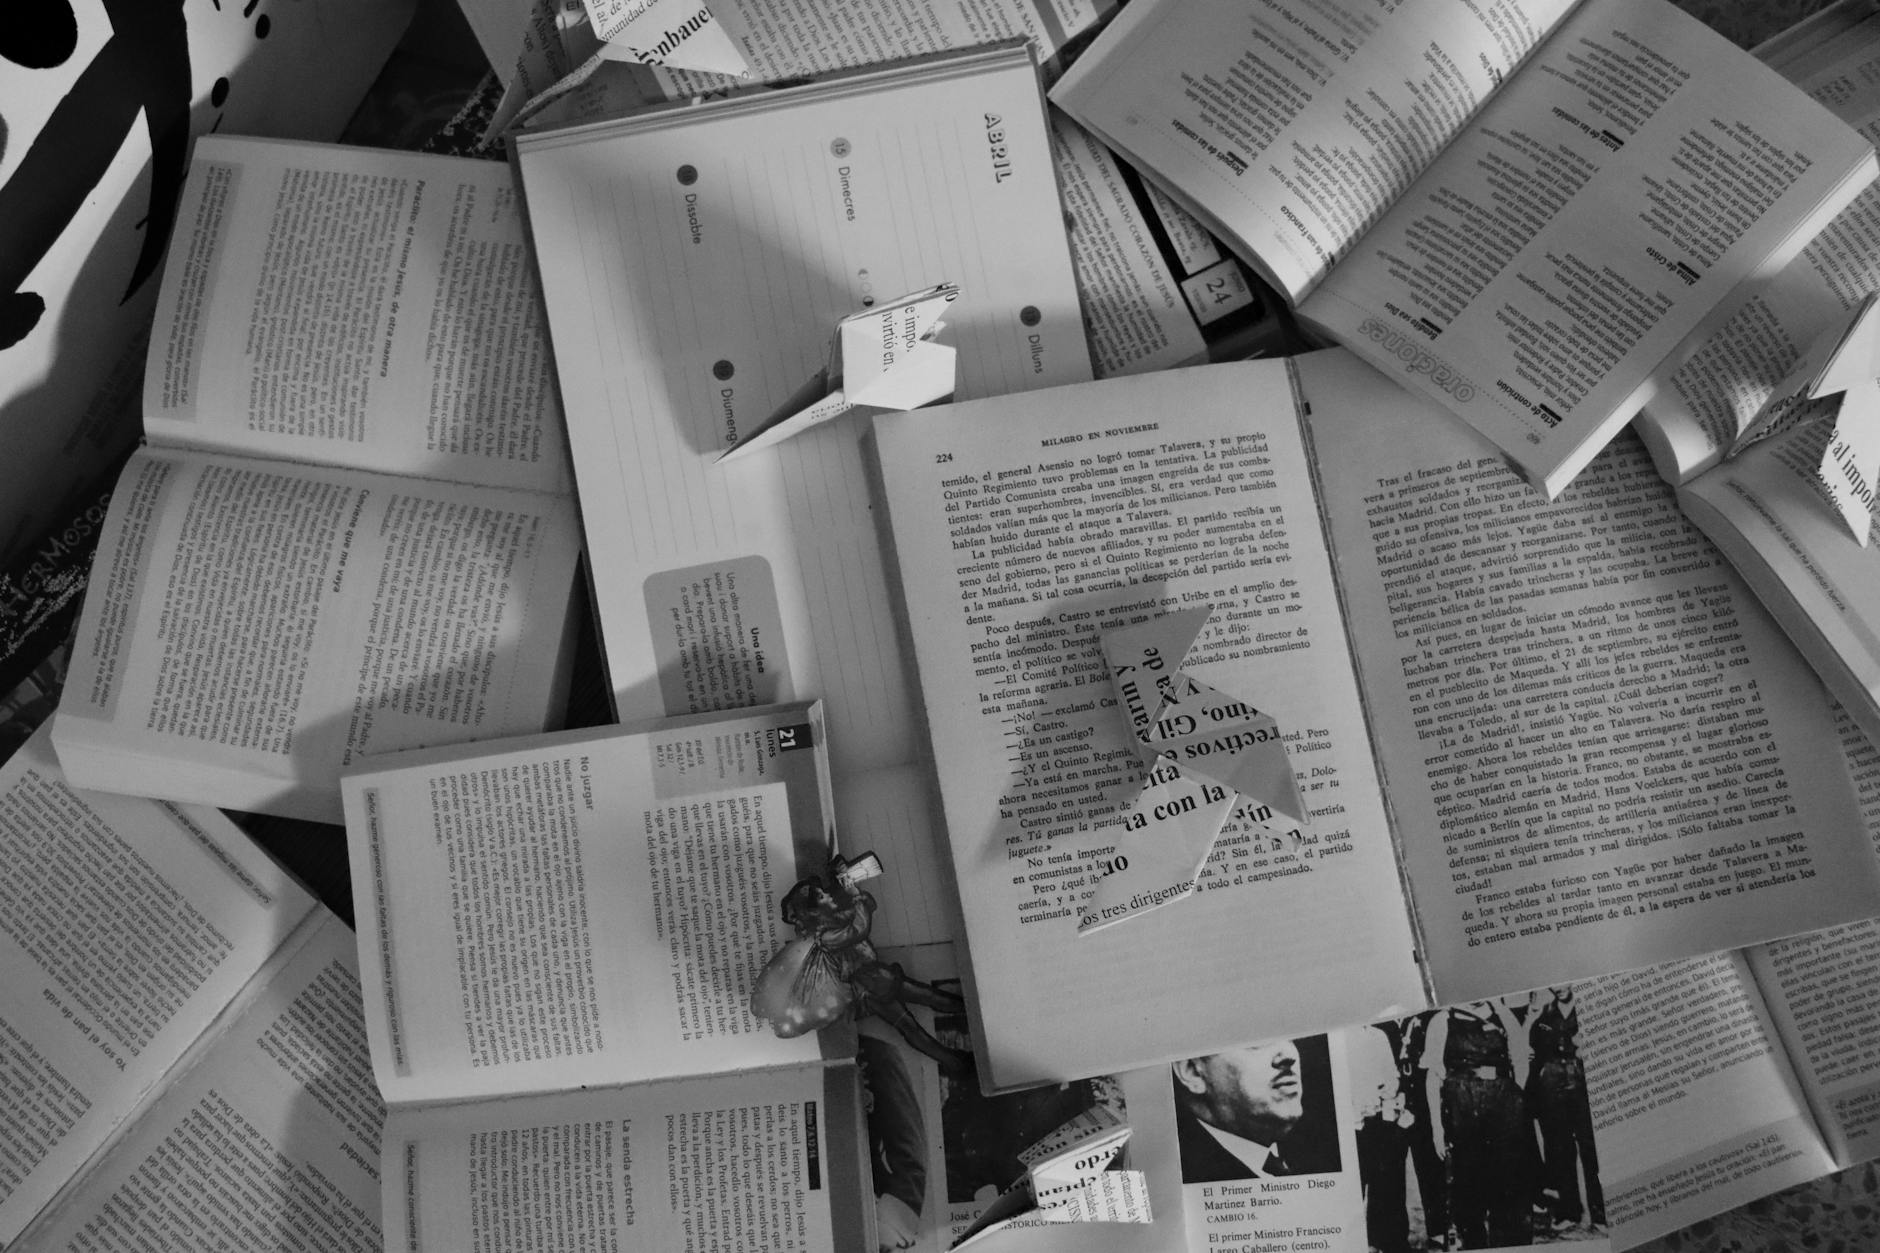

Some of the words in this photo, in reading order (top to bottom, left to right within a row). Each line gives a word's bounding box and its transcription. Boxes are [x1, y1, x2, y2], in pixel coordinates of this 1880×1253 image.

[983, 112, 1012, 184] ABRIL
[837, 165, 855, 222] Dimecres
[683, 192, 703, 244] Dissable
[1105, 179, 1132, 224] SAGRADO
[1127, 223, 1155, 270] CORAZÓN
[1205, 276, 1233, 305] 24
[389, 300, 399, 314] de
[385, 315, 396, 337] otra
[900, 316, 919, 349] impo
[379, 338, 392, 378] manera
[1027, 333, 1044, 374] Dilluns
[1355, 316, 1477, 403] oraciones
[935, 452, 954, 464] 224
[1040, 433, 1084, 447] MILAGRO
[1087, 431, 1101, 441] EN
[1104, 421, 1159, 438] NOVIEMBRE
[940, 473, 979, 488] temido,
[981, 470, 992, 481] el
[996, 464, 1032, 481] general
[1037, 459, 1074, 473] Asensio
[1079, 457, 1093, 466] no
[1096, 450, 1123, 465] logró
[1126, 447, 1156, 459] tomar
[1159, 440, 1205, 454] Talavera,
[1208, 438, 1216, 449] y
[1219, 436, 1232, 445] su
[1235, 431, 1266, 445] propio
[347, 488, 370, 528] Conviene
[342, 529, 354, 549] que
[337, 550, 348, 567] me
[331, 569, 344, 593] vaya
[749, 626, 760, 649] Una
[1202, 634, 1252, 651] nombrado
[1255, 630, 1292, 643] director
[1295, 626, 1308, 637] de
[1415, 636, 1432, 648] Así
[1435, 632, 1462, 646] pues,
[1464, 628, 1477, 637] en
[1480, 621, 1506, 634] lugar
[1510, 617, 1522, 628] de
[1525, 612, 1557, 624] iniciar
[754, 650, 765, 675] idea
[1141, 646, 1164, 670] de
[777, 727, 796, 748] 21
[1054, 725, 1094, 743] castigo?
[1154, 713, 1197, 739] Gil
[765, 727, 777, 759] lunes
[1052, 742, 1093, 756] ascenso.
[579, 755, 589, 772] No
[579, 774, 593, 810] juzgar
[1153, 794, 1198, 821] con
[1200, 783, 1227, 805] la
[1206, 877, 1230, 890] todo
[1232, 873, 1244, 886] el
[1246, 862, 1313, 883] campesinado.
[1474, 890, 1511, 905] Franco
[1514, 882, 1547, 896] estaba
[1551, 875, 1587, 889] furioso
[1591, 870, 1610, 881] con
[1613, 863, 1646, 877] Yagüe
[1650, 859, 1668, 872] por
[1672, 852, 1702, 866] haber
[1708, 842, 1747, 858] dañado
[1100, 902, 1128, 919] tres
[1129, 878, 1195, 910] dirigentes
[42, 987, 61, 1007] vida
[60, 1005, 74, 1018] de
[72, 1016, 92, 1035] pan
[87, 1032, 100, 1044] el
[97, 1041, 116, 1058] soy
[789, 1102, 799, 1116] En
[621, 1118, 632, 1133] La
[788, 1118, 801, 1145] aquel
[621, 1135, 632, 1171] senda
[790, 1148, 801, 1186] tiempo,
[622, 1173, 635, 1226] estrecha
[792, 1188, 805, 1208] dijo
[1203, 1187, 1213, 1197] El
[1221, 1186, 1253, 1196] Primer
[1260, 1182, 1300, 1193] Ministro
[1307, 1179, 1336, 1190] Diego
[1249, 1196, 1282, 1207] Barrio.
[794, 1211, 807, 1237] Jesús
[949, 1210, 971, 1223] José
[1206, 1212, 1245, 1224] CAMBIO
[1247, 1212, 1258, 1221] 16.
[1208, 1232, 1219, 1243] El
[1221, 1232, 1252, 1244] primer
[1253, 1229, 1294, 1240] Ministro
[1295, 1226, 1342, 1237] Francisco
[1241, 1242, 1288, 1252] Caballero
[1291, 1239, 1330, 1252] (centro).
